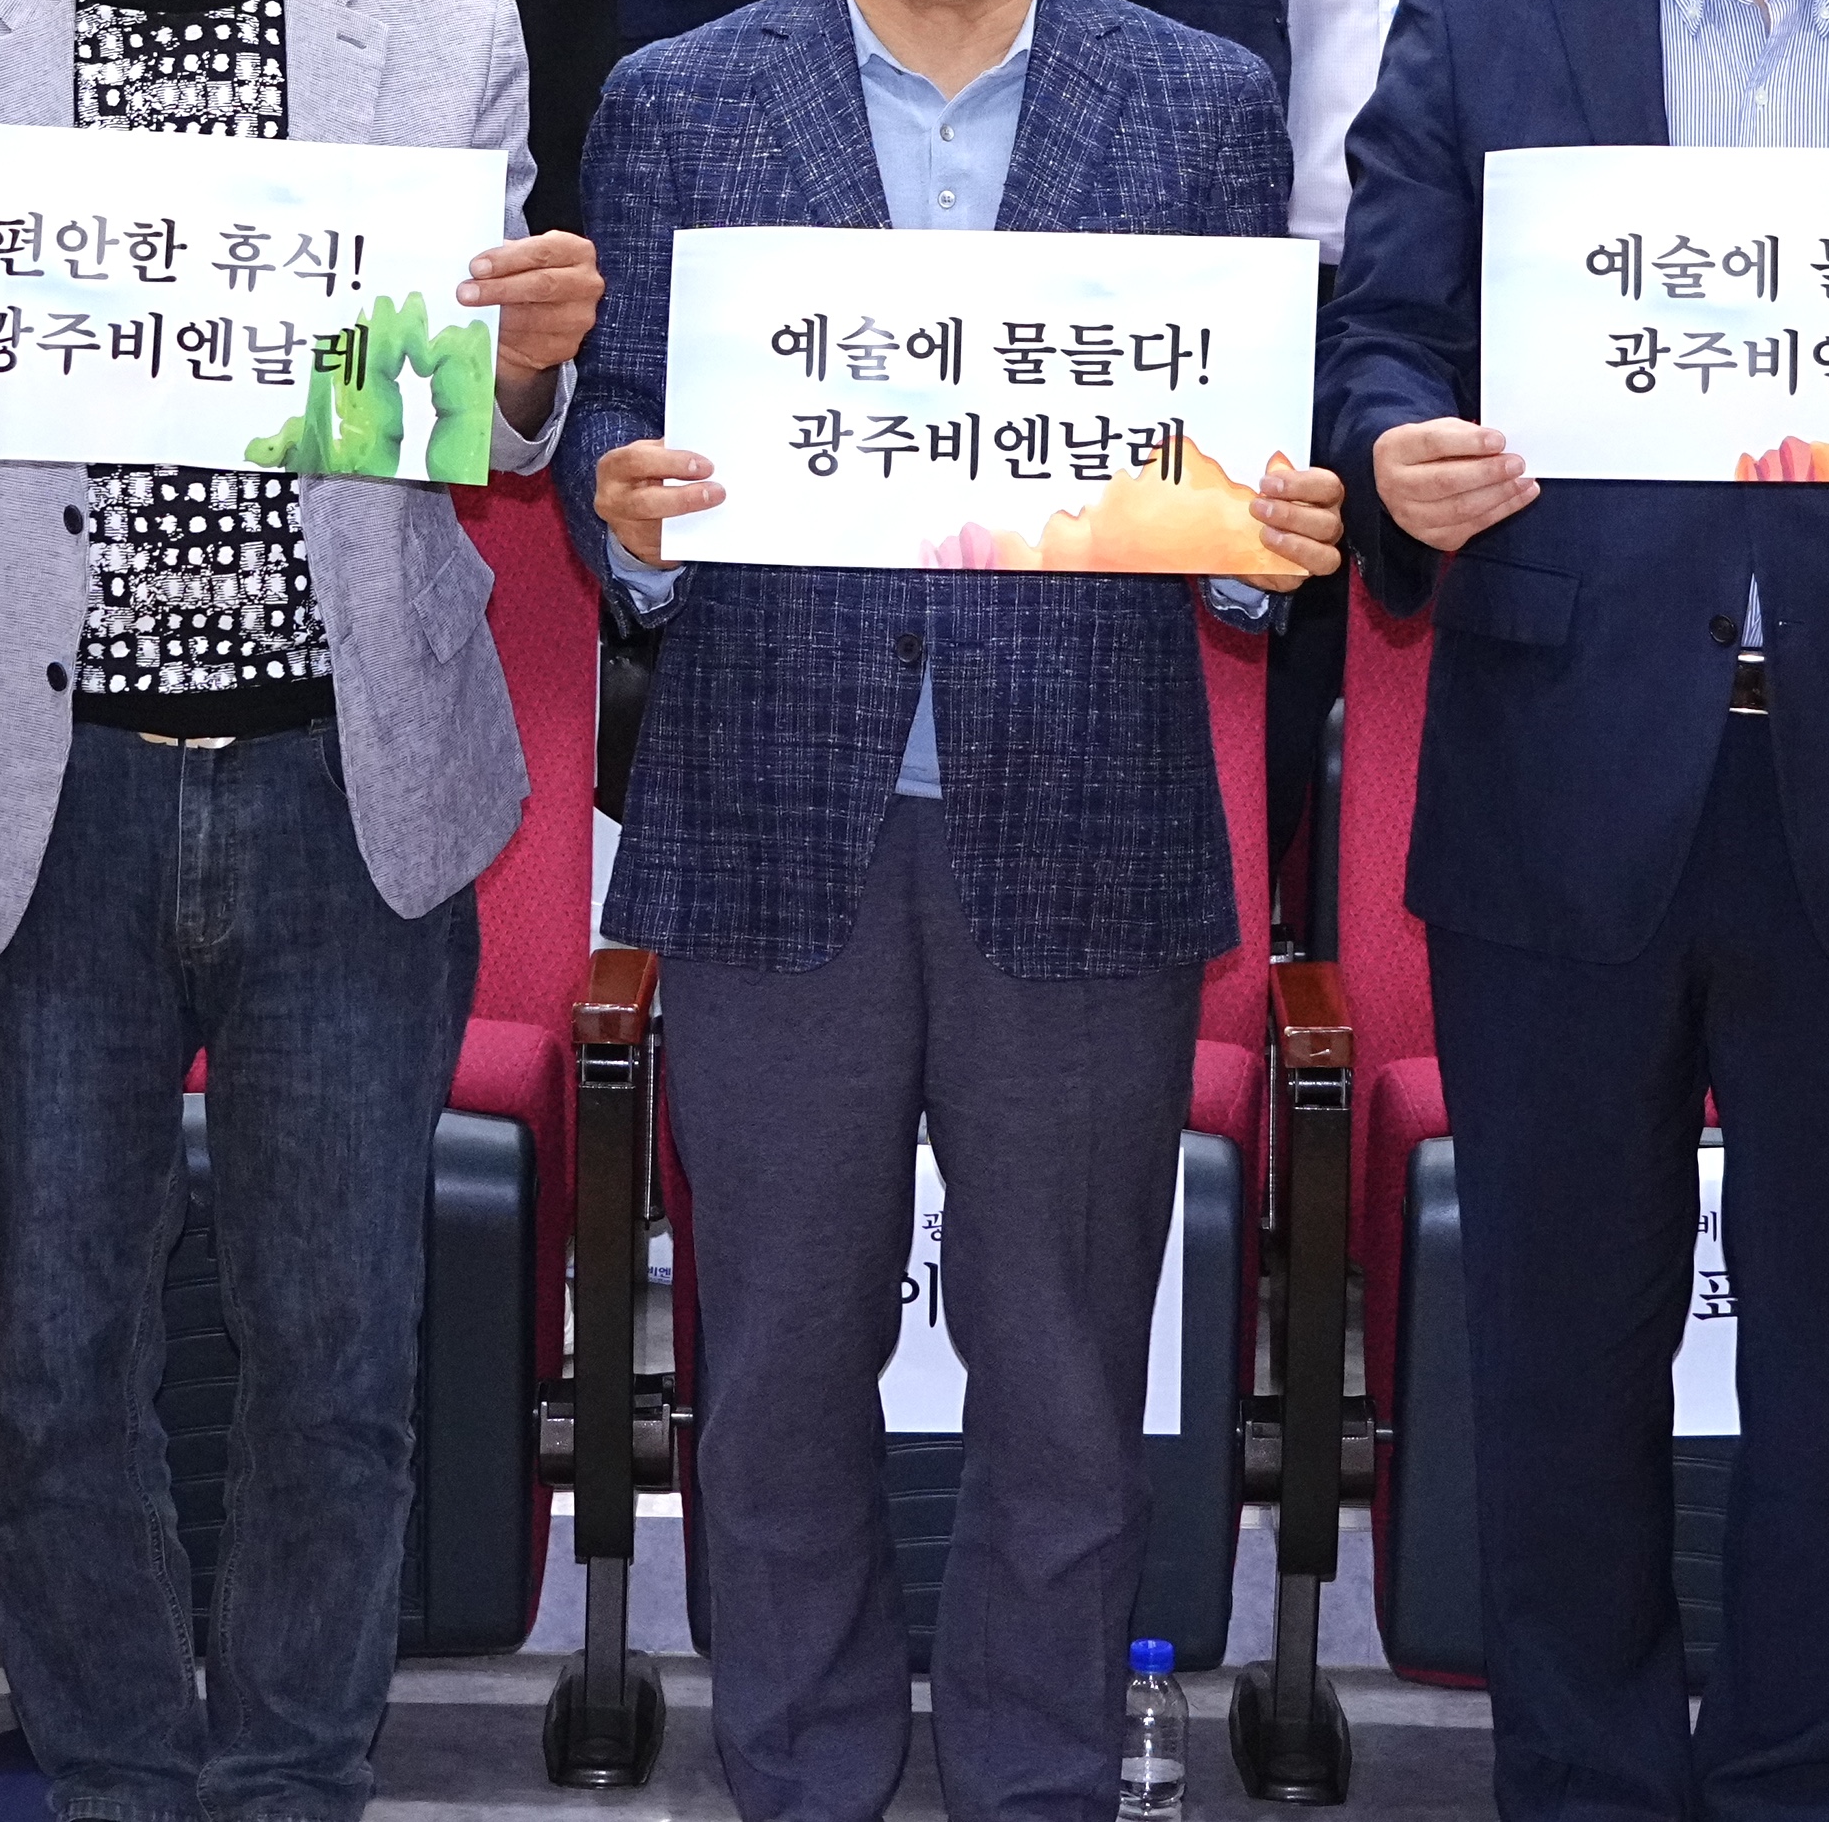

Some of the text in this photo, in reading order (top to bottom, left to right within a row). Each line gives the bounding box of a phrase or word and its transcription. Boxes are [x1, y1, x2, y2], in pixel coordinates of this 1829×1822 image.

[212, 223, 366, 299] 휴식!
[1584, 232, 1782, 304] 예술에
[770, 312, 1213, 392] 예술에 물들다!
[788, 406, 1186, 487] 광주비엔날레
